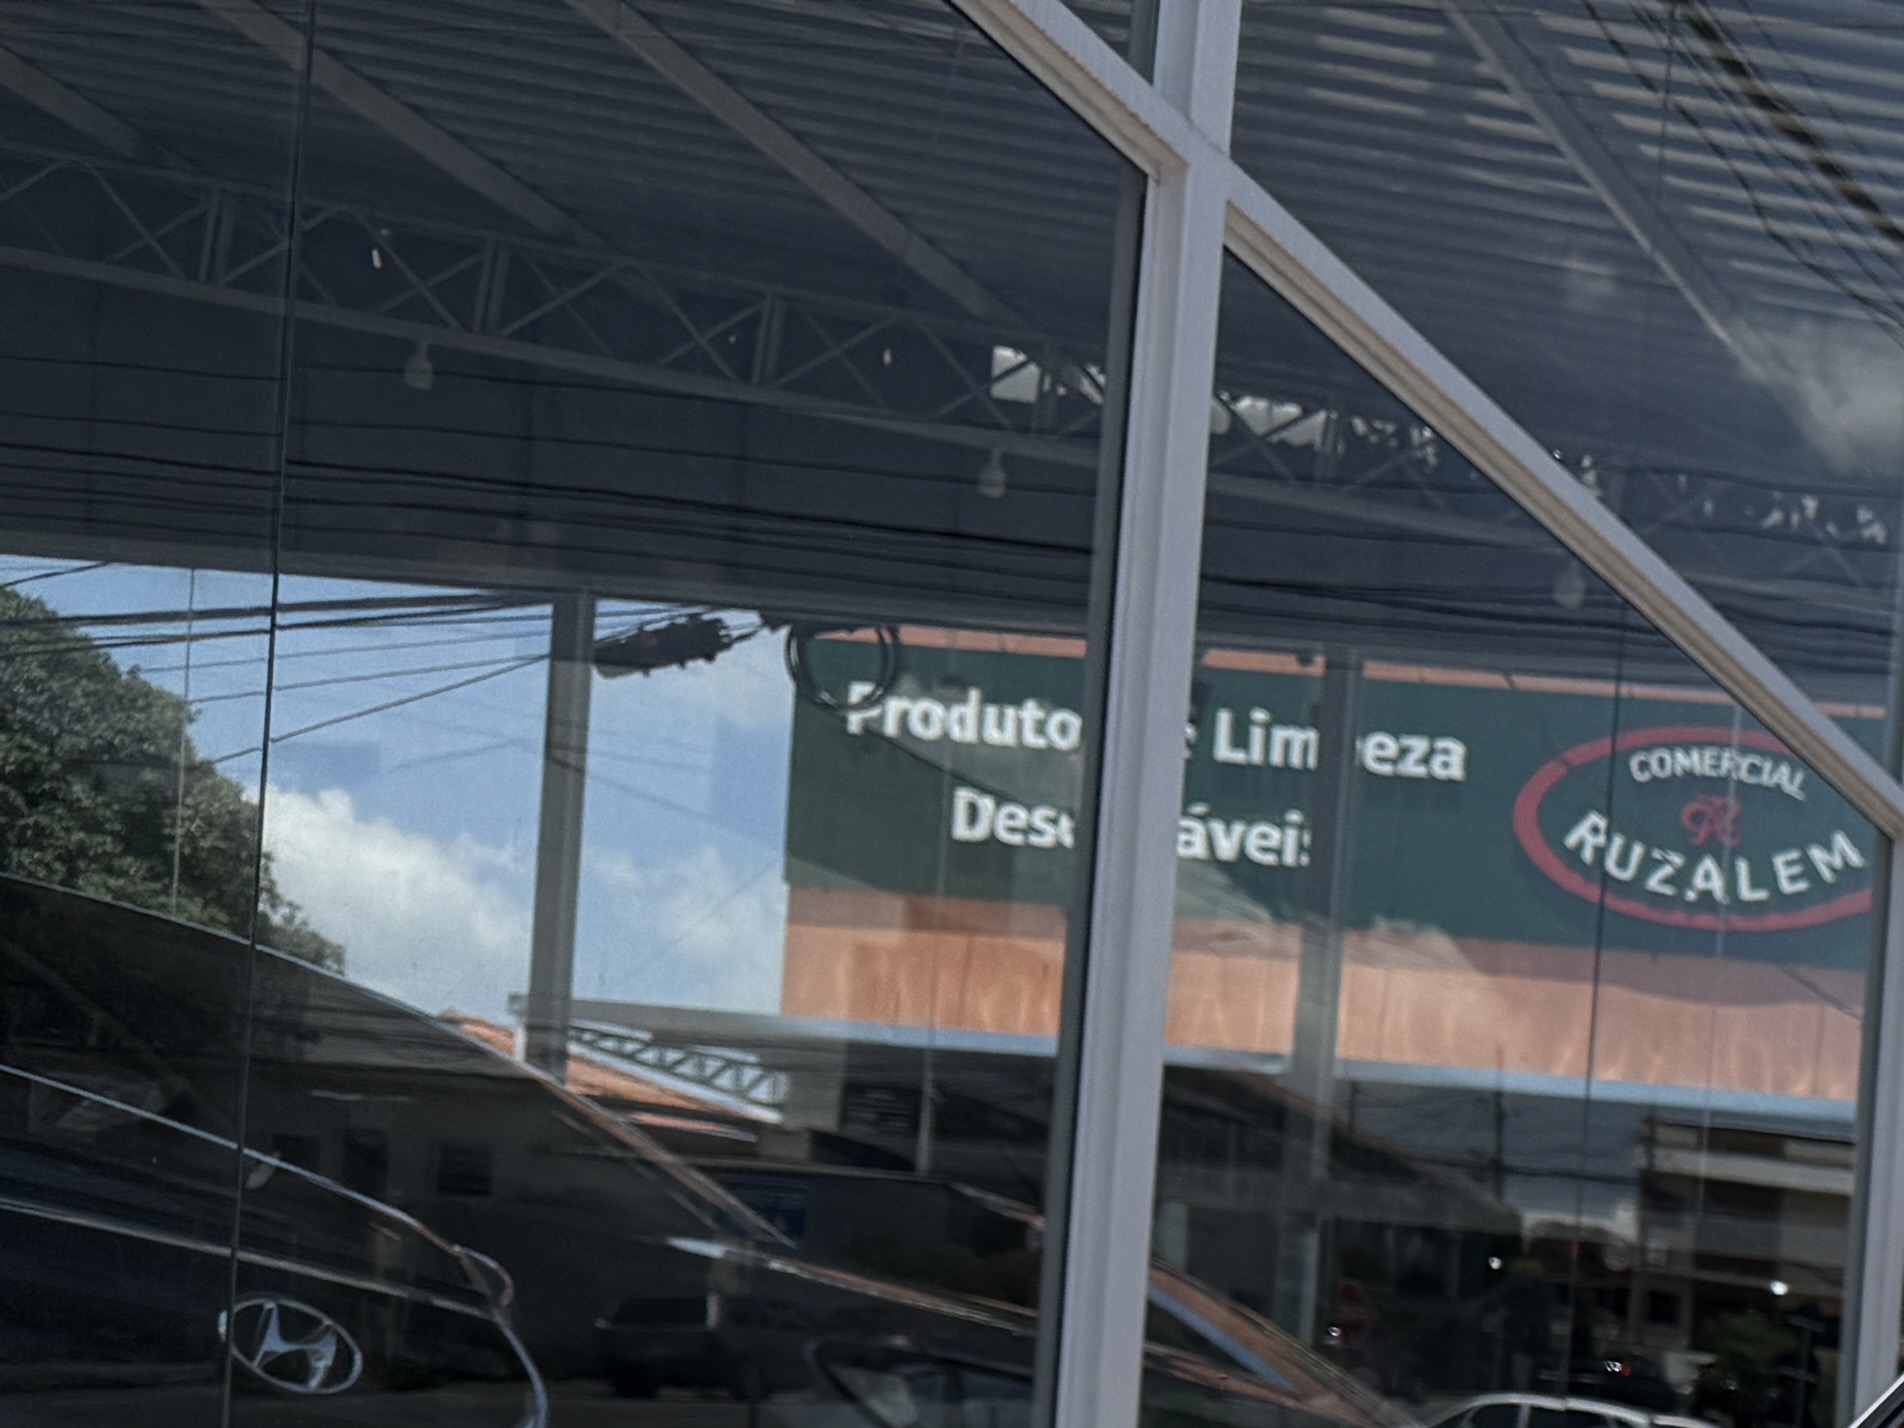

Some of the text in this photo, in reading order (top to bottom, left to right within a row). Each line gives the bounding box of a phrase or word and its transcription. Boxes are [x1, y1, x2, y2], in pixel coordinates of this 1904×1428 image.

[846, 680, 1083, 751] Produto
[1213, 707, 1467, 781] Limeza
[1629, 746, 1806, 801] COMERCIAL
[1563, 809, 1865, 905] RUZALEM
